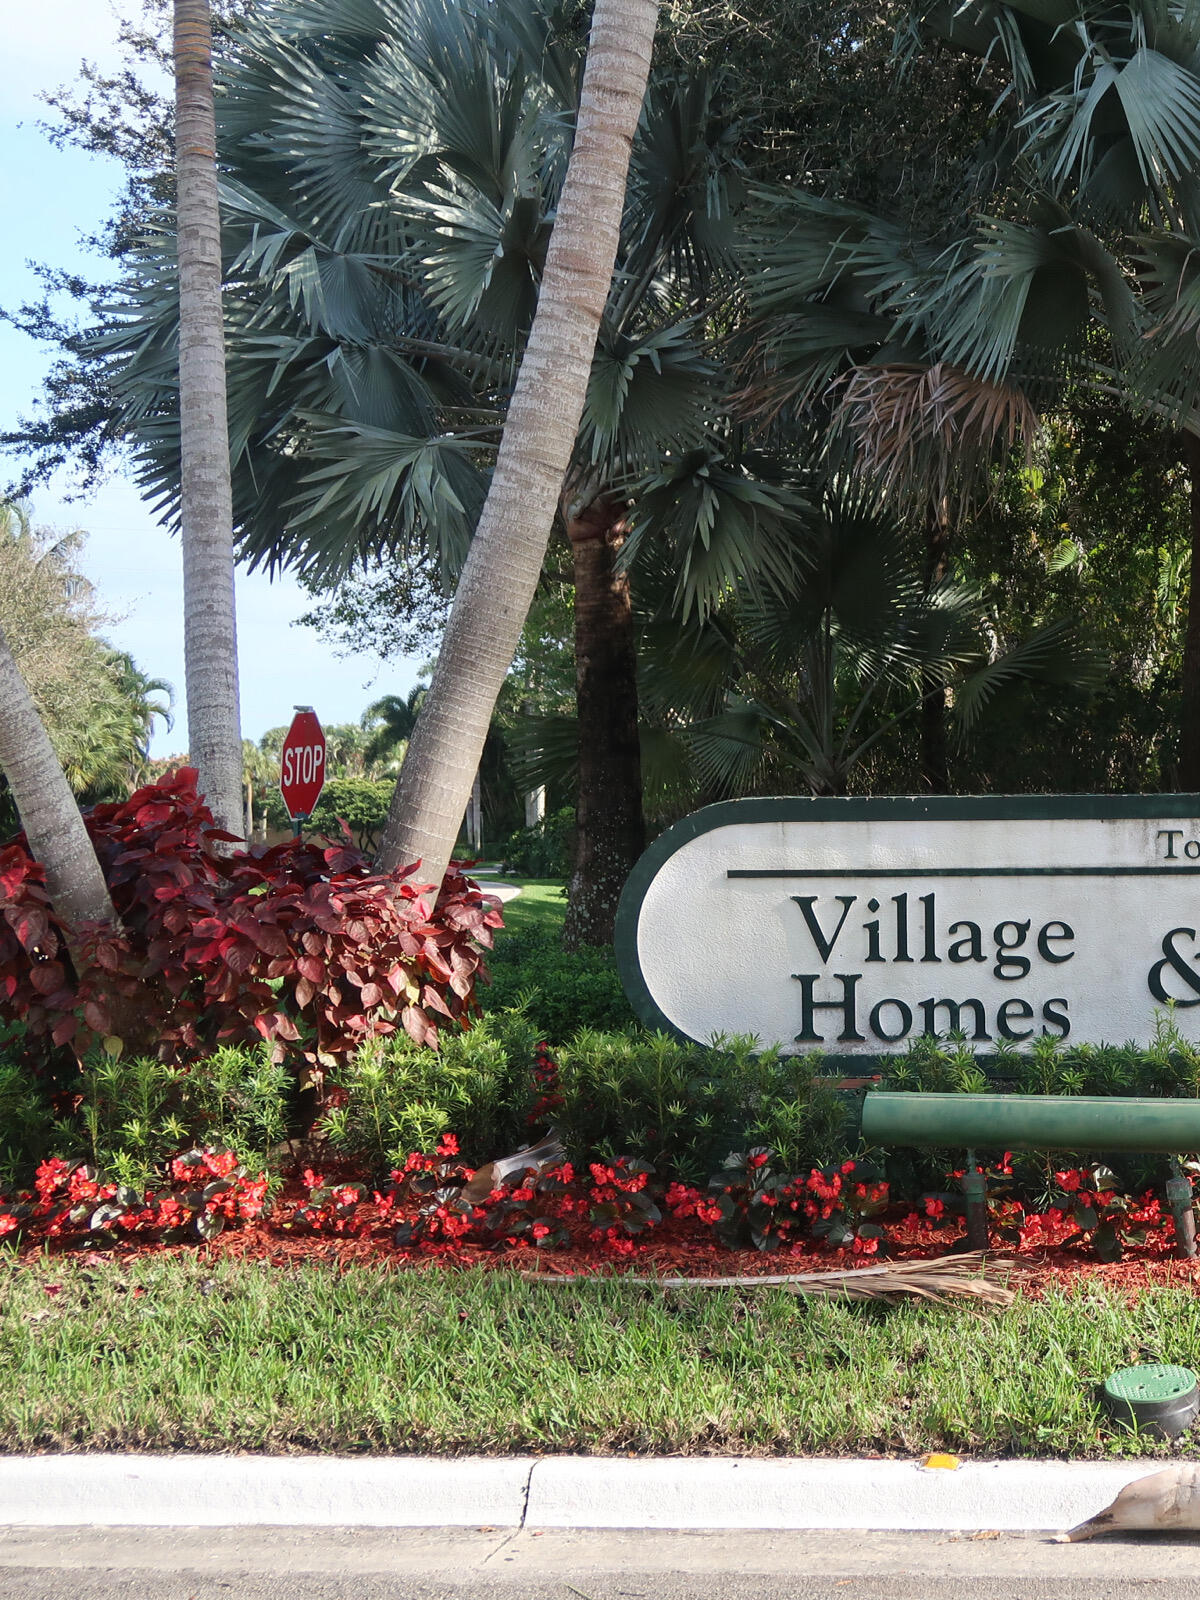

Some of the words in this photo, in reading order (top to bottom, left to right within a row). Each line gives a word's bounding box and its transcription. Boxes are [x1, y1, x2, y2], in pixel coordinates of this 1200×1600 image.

[283, 744, 323, 787] STOP
[790, 892, 1076, 981] Village
[790, 973, 1072, 1043] Homes
